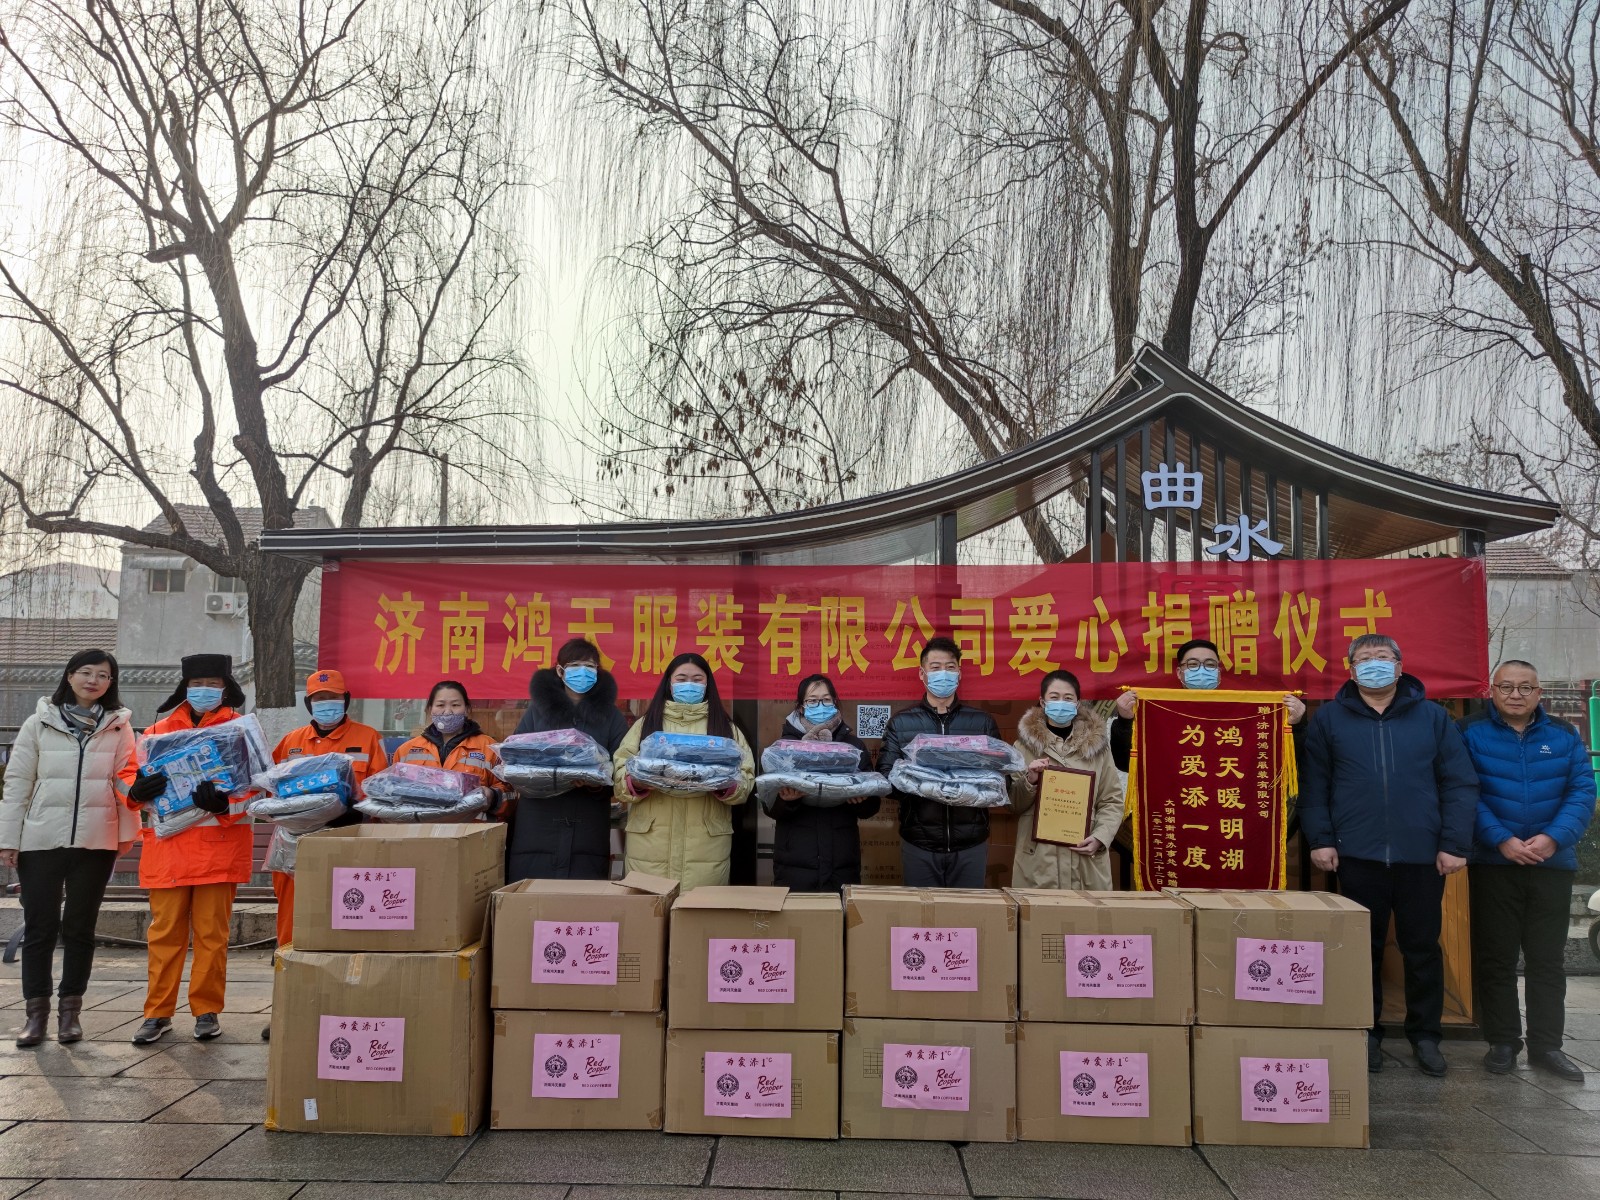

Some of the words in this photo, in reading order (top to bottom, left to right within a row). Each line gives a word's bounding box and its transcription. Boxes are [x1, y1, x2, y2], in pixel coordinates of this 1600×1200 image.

[1141, 462, 1203, 510] 曲
[1206, 514, 1284, 562] 水
[374, 588, 1393, 676] 济南鸿天服装有限公司爱心捐赠仪式
[1179, 724, 1210, 870] 为爱添一度
[1214, 726, 1245, 870] 鸿天暖明湖
[382, 889, 400, 902] Red
[384, 898, 407, 907] Copper
[584, 944, 603, 957] Red
[944, 950, 962, 963] Red
[586, 953, 609, 962] Copper
[946, 958, 969, 968] Copper
[1119, 956, 1138, 970] Red
[761, 962, 780, 975] Red
[763, 970, 786, 979] Copper
[1121, 965, 1144, 974] Copper
[1290, 963, 1308, 976] Red
[1292, 972, 1315, 981] Copper
[369, 1040, 389, 1052] Red
[371, 1049, 395, 1058] Copper
[585, 1056, 604, 1070] Red
[587, 1066, 611, 1075] Copper
[936, 1069, 955, 1081] Red
[758, 1076, 777, 1090] Red
[938, 1078, 962, 1088] Copper
[1114, 1075, 1133, 1088] Red
[1295, 1081, 1314, 1094] Red
[759, 1084, 783, 1094] Copper
[1116, 1084, 1140, 1093] Copper
[1297, 1090, 1322, 1099] Copper
